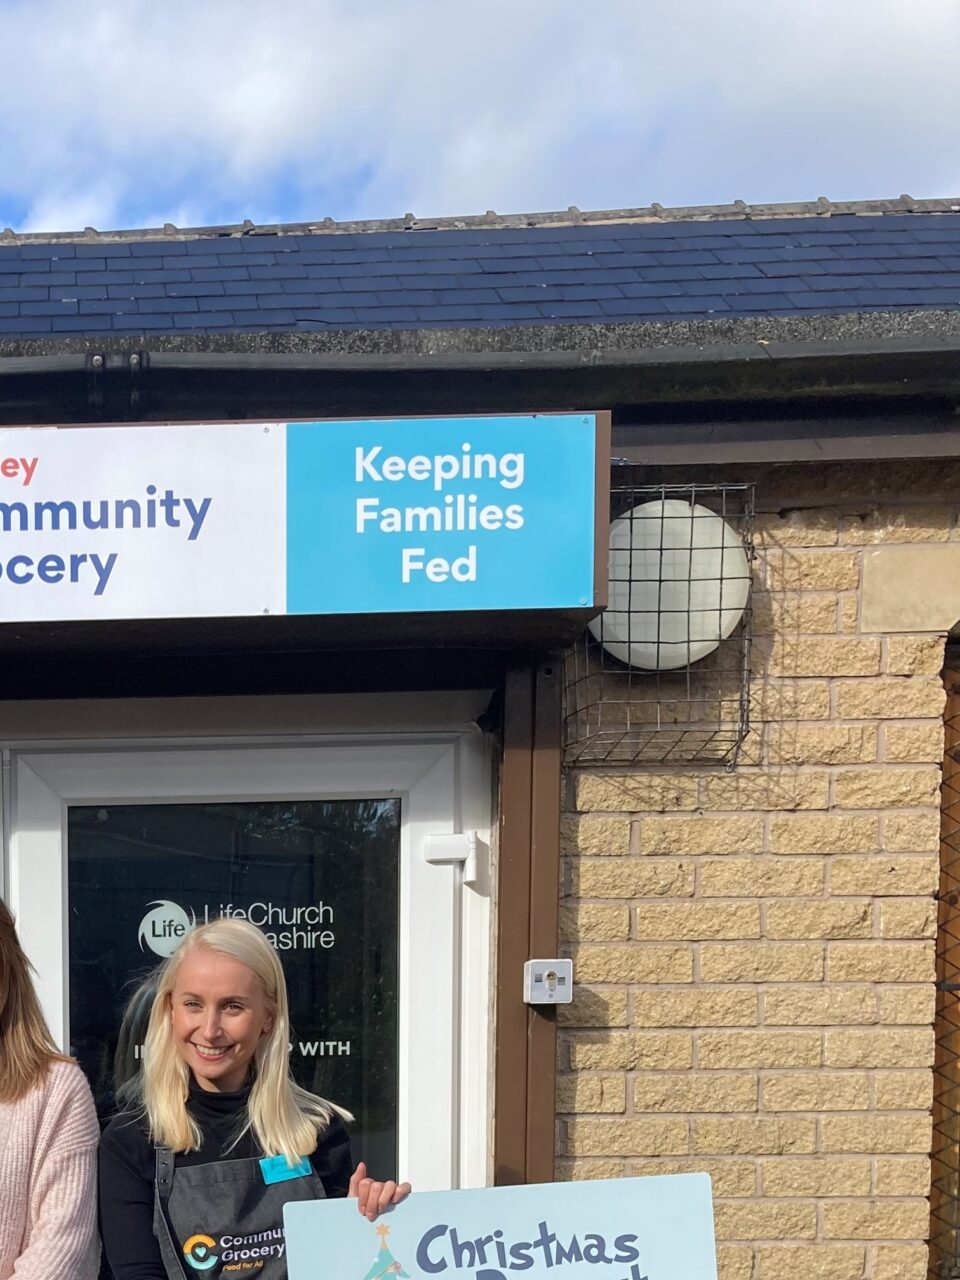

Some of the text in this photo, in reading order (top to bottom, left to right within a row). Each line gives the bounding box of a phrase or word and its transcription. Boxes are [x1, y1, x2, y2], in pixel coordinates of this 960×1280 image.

[353, 445, 526, 491] Keeping
[354, 494, 525, 534] Families
[401, 545, 476, 584] Fed
[152, 920, 185, 938] Life
[267, 927, 334, 949] ashire
[299, 1041, 350, 1056] WITH
[220, 1228, 284, 1248] Commu
[416, 1220, 639, 1273] Christmas
[222, 1244, 285, 1261] Grocery
